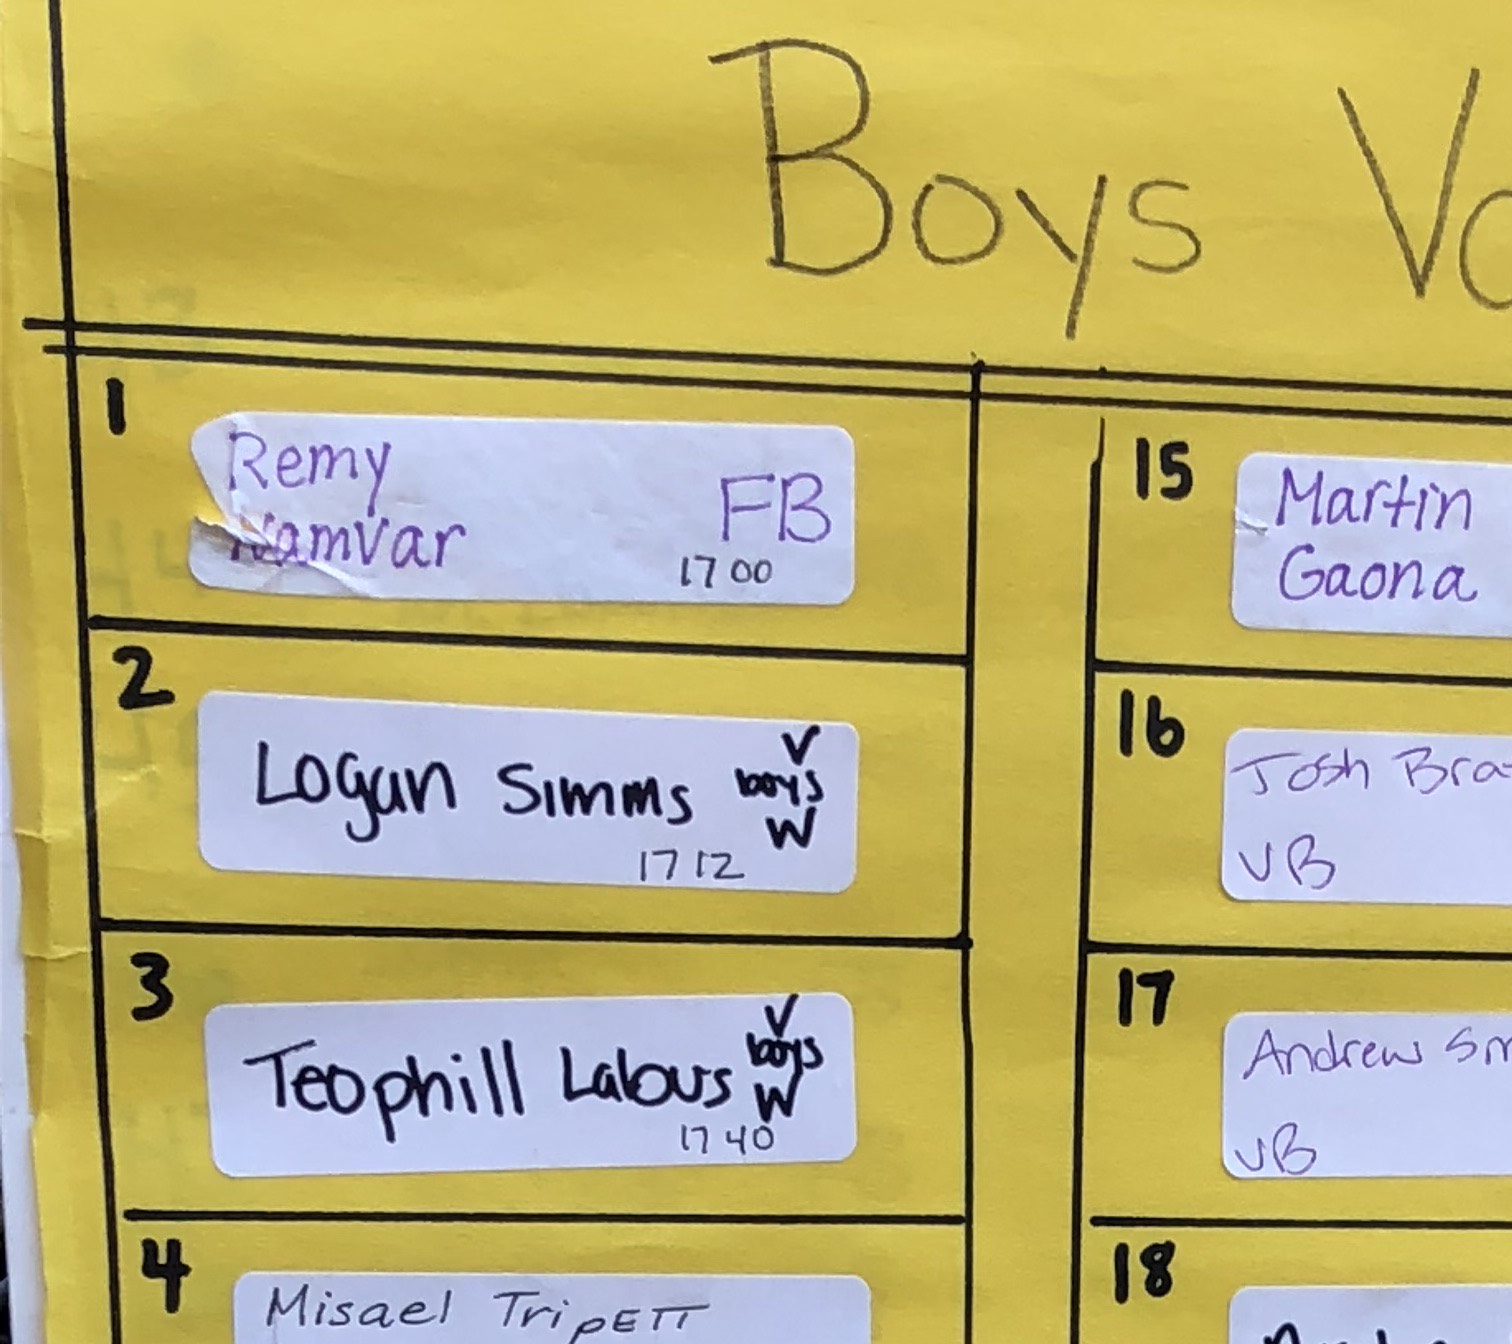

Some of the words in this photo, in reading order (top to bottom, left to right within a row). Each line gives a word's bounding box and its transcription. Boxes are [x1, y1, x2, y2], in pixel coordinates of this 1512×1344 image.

[707, 37, 1202, 341] Boys
[105, 377, 127, 436] 1
[225, 425, 392, 523] Remy
[1136, 436, 1193, 501] 15
[1275, 465, 1472, 532] Martin
[720, 472, 832, 544] FB
[1279, 542, 1478, 602] Gaona
[112, 644, 178, 711] 2
[1119, 688, 1186, 758] 16
[1230, 745, 1369, 796] Josh
[764, 803, 818, 851] W
[1238, 834, 1336, 890] VB
[128, 951, 174, 1022] 3
[1118, 967, 1175, 1027] 17
[1242, 1025, 1423, 1080] Andrew
[242, 1038, 525, 1144] Teophill
[1234, 1122, 1317, 1176] VB
[139, 1237, 193, 1314] 4
[1113, 1239, 1176, 1305] 18
[266, 1281, 452, 1329] Misael
